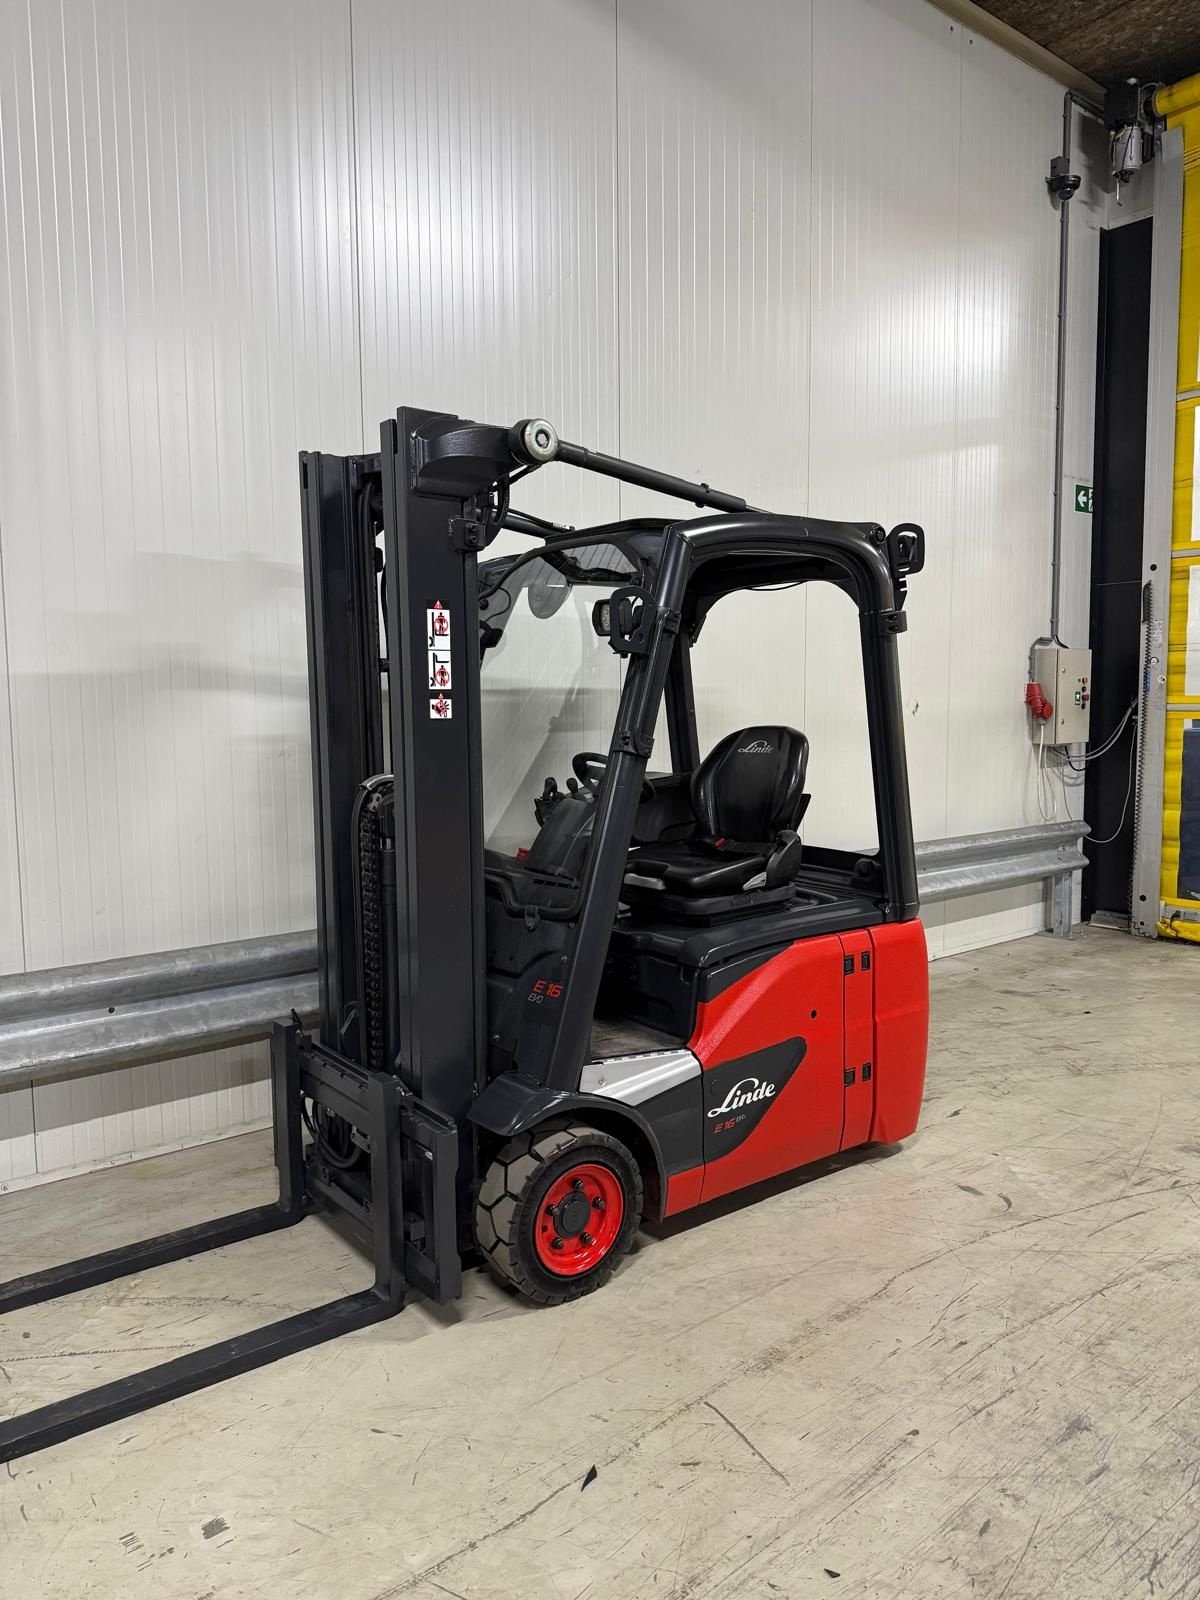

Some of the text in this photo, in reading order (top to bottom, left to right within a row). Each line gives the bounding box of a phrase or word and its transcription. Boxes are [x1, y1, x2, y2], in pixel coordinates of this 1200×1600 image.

[737, 740, 774, 753] Linde
[533, 980, 564, 998] E 16
[707, 1077, 776, 1118] Linde
[714, 1123, 724, 1134] E
[724, 1118, 736, 1130] 16
